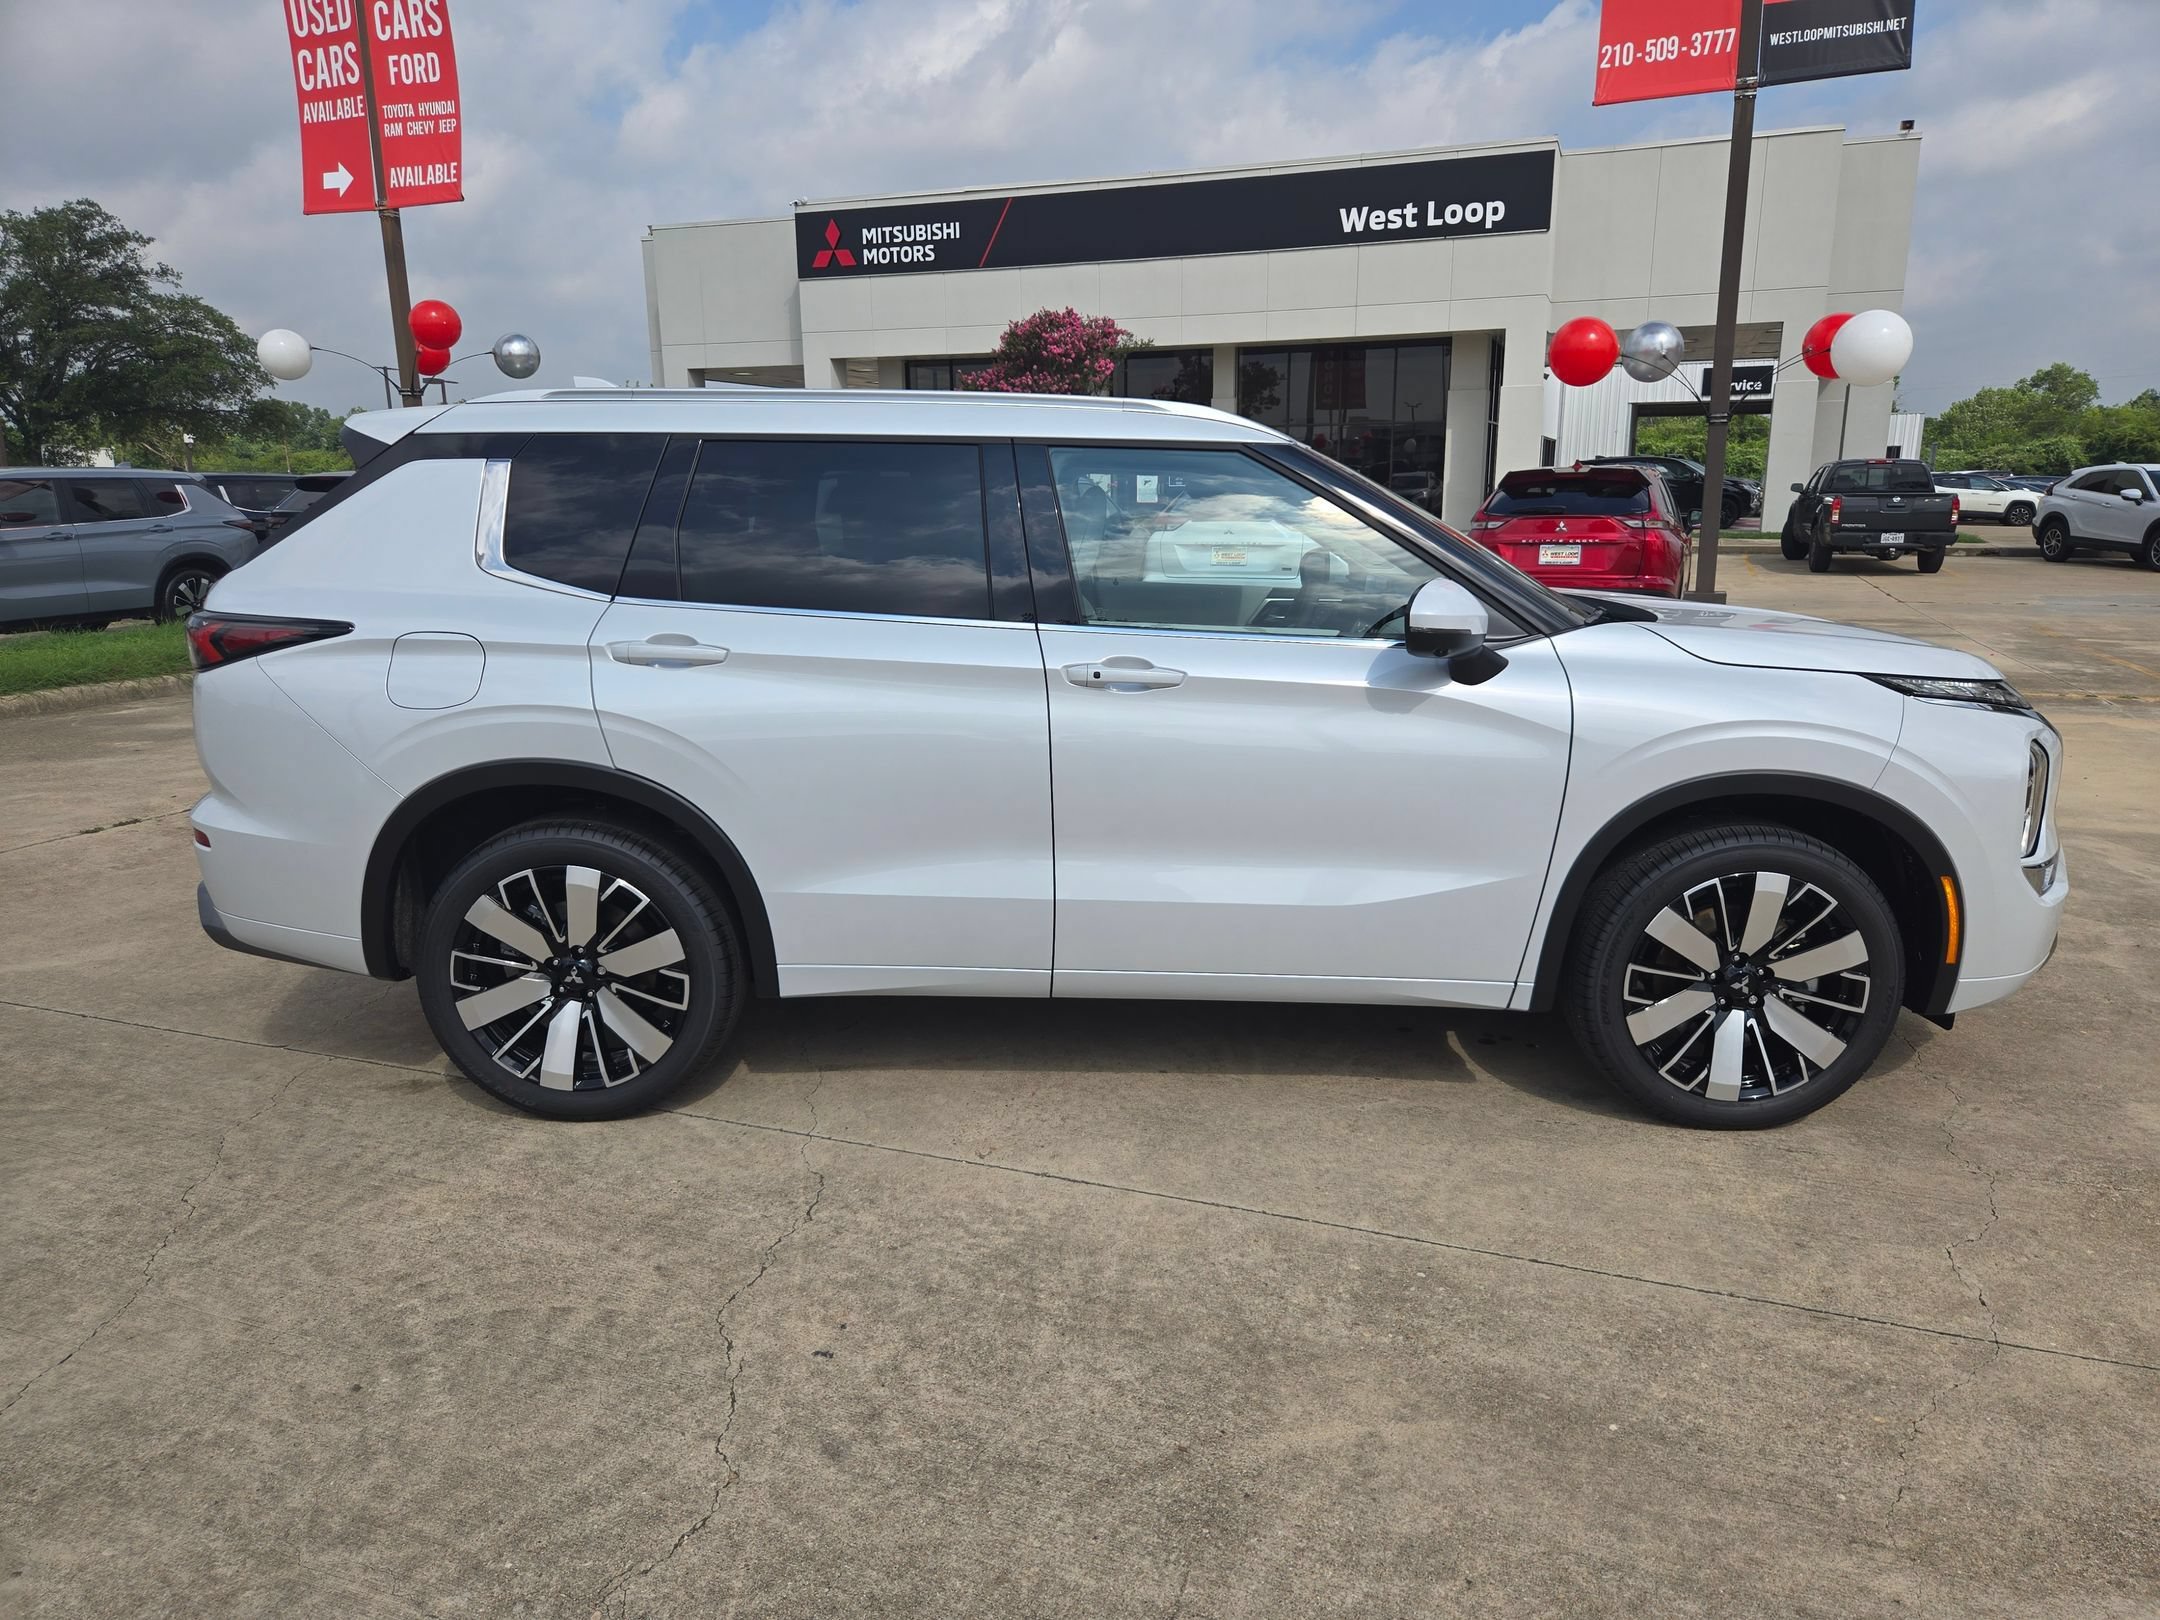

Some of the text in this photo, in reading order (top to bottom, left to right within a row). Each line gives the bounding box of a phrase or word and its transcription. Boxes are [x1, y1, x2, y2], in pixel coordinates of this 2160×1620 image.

[288, 0, 352, 37] USED
[373, 0, 443, 41] CARS
[1769, 16, 1908, 46] WESTLOOPMITSUBISHI.NET
[297, 41, 361, 91] CARS
[388, 52, 441, 85] FORD
[303, 95, 365, 124] AVAILABLE
[382, 100, 456, 119] TOYOTA HYUNDAI
[384, 118, 457, 138] RAM CHEVY JEEP
[390, 162, 458, 188] AVAILABLE
[1339, 200, 1506, 233] West Loop
[861, 221, 961, 245] MITSUBISHI
[863, 244, 936, 265] MOTORS
